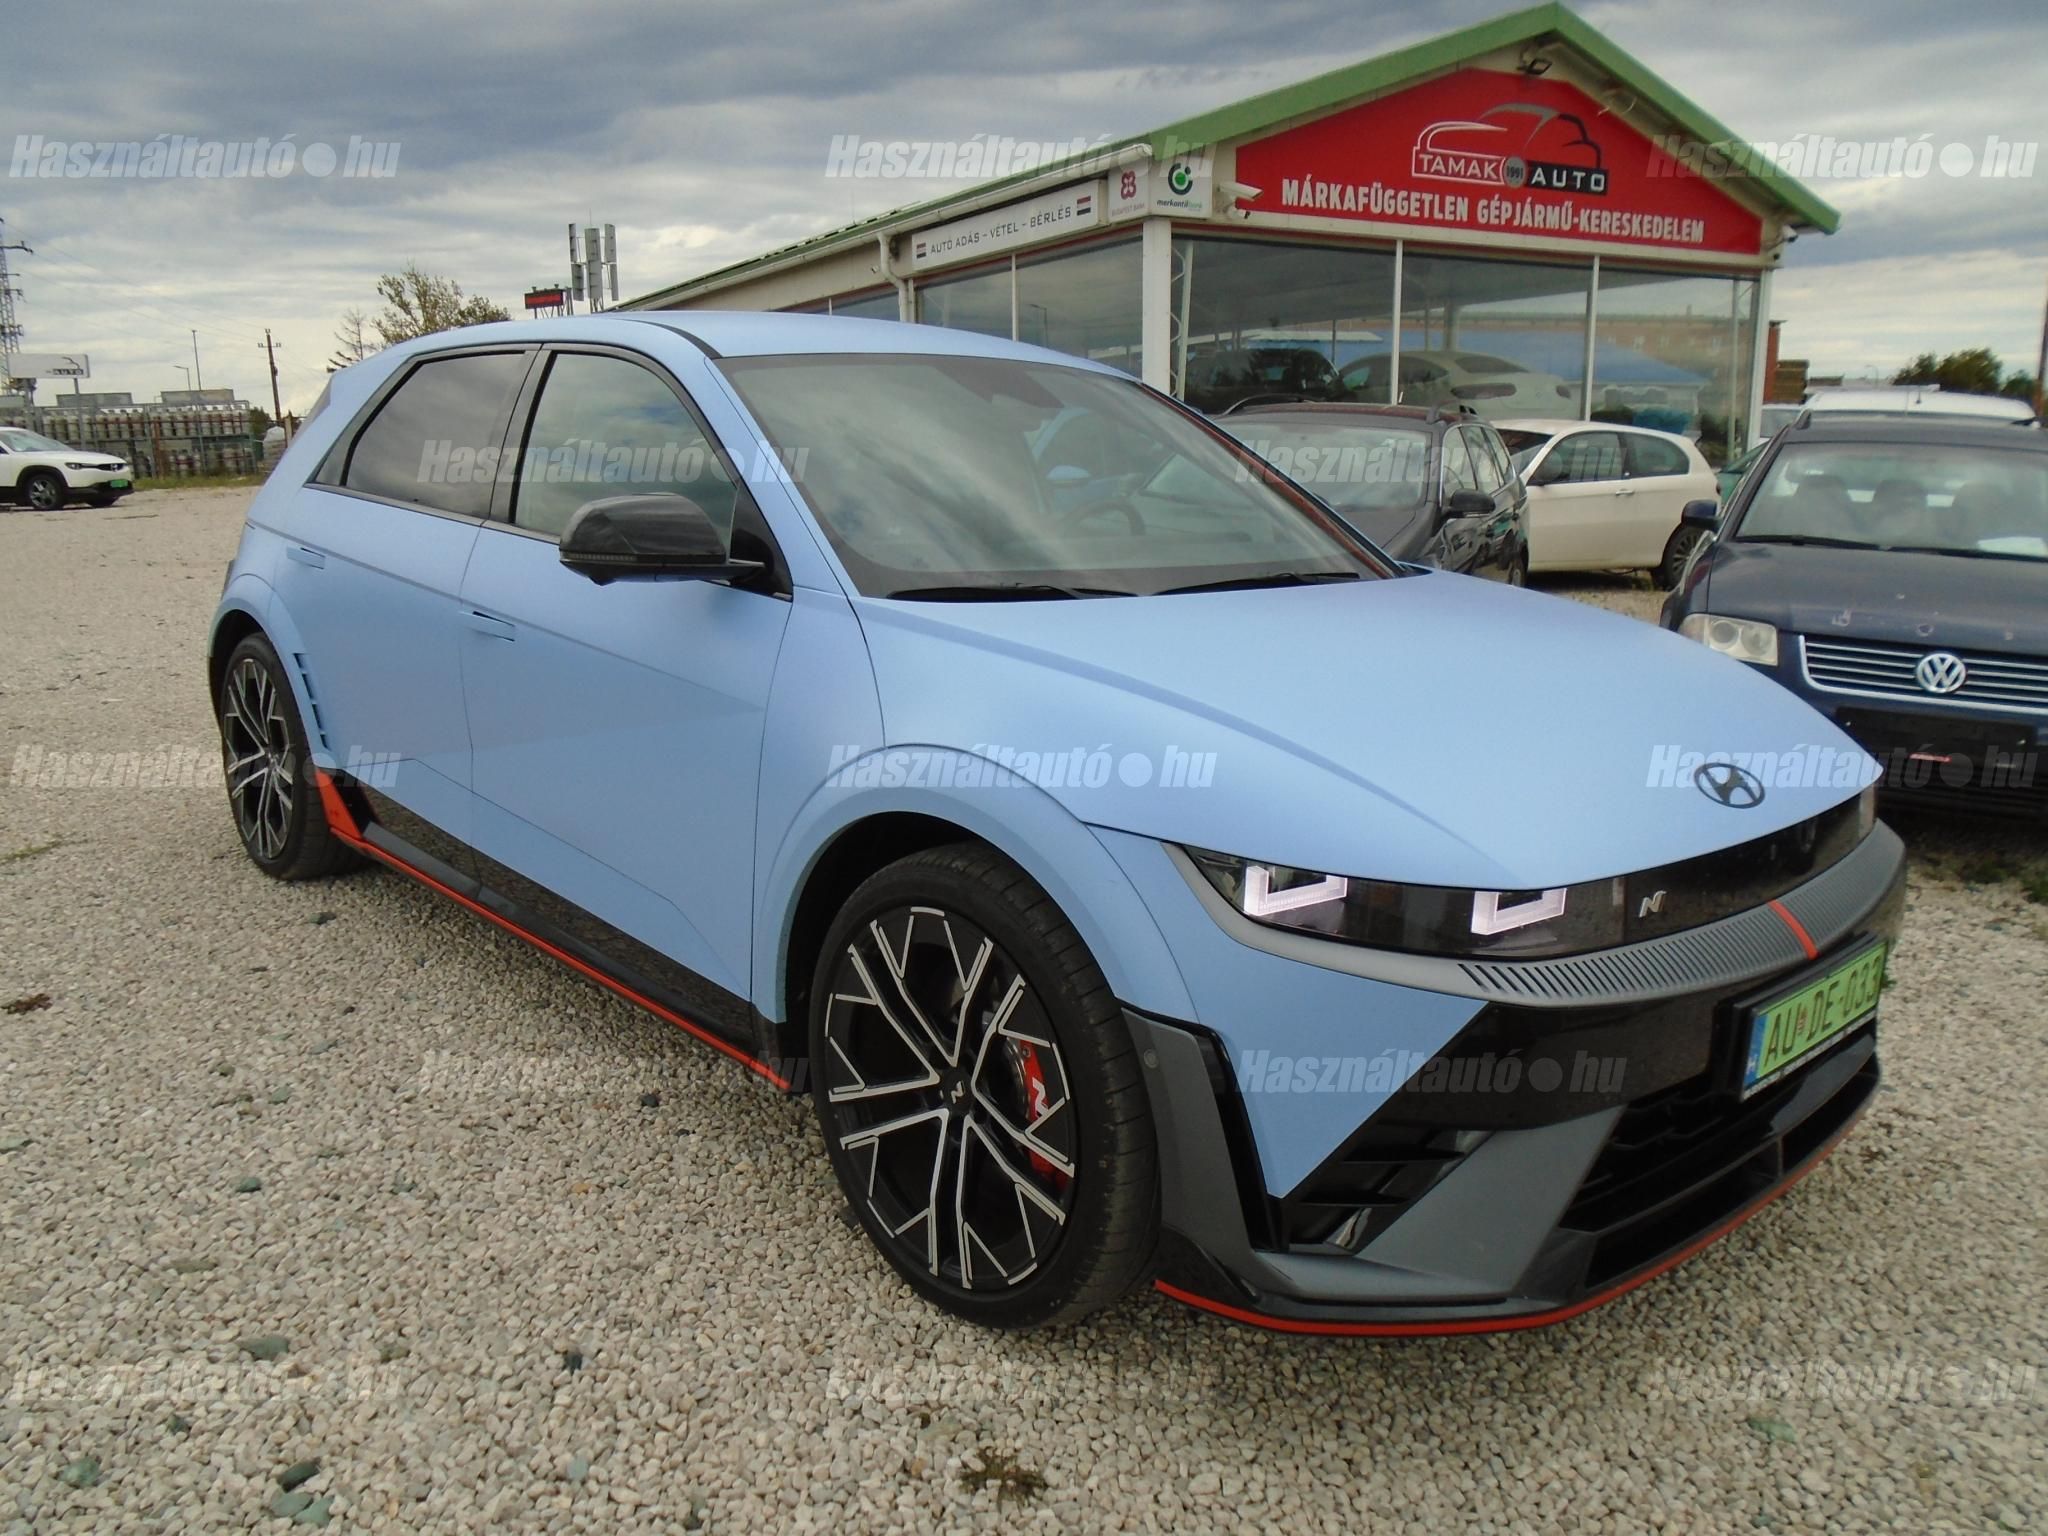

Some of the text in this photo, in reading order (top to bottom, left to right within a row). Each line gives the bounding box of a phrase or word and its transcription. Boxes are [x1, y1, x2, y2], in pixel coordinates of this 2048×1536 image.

[1419, 153, 1498, 179] TAMAK
[1531, 167, 1605, 192] AUTO
[931, 239, 953, 254] AUTO
[955, 231, 980, 248] ADÁS
[990, 222, 1019, 240] VÉTEL
[1030, 204, 1072, 228] BÉRLÉS
[1282, 173, 1705, 243] MÁRKAFÜGGETLEN GÉPJÁRMŰ-KERESKEDELEM
